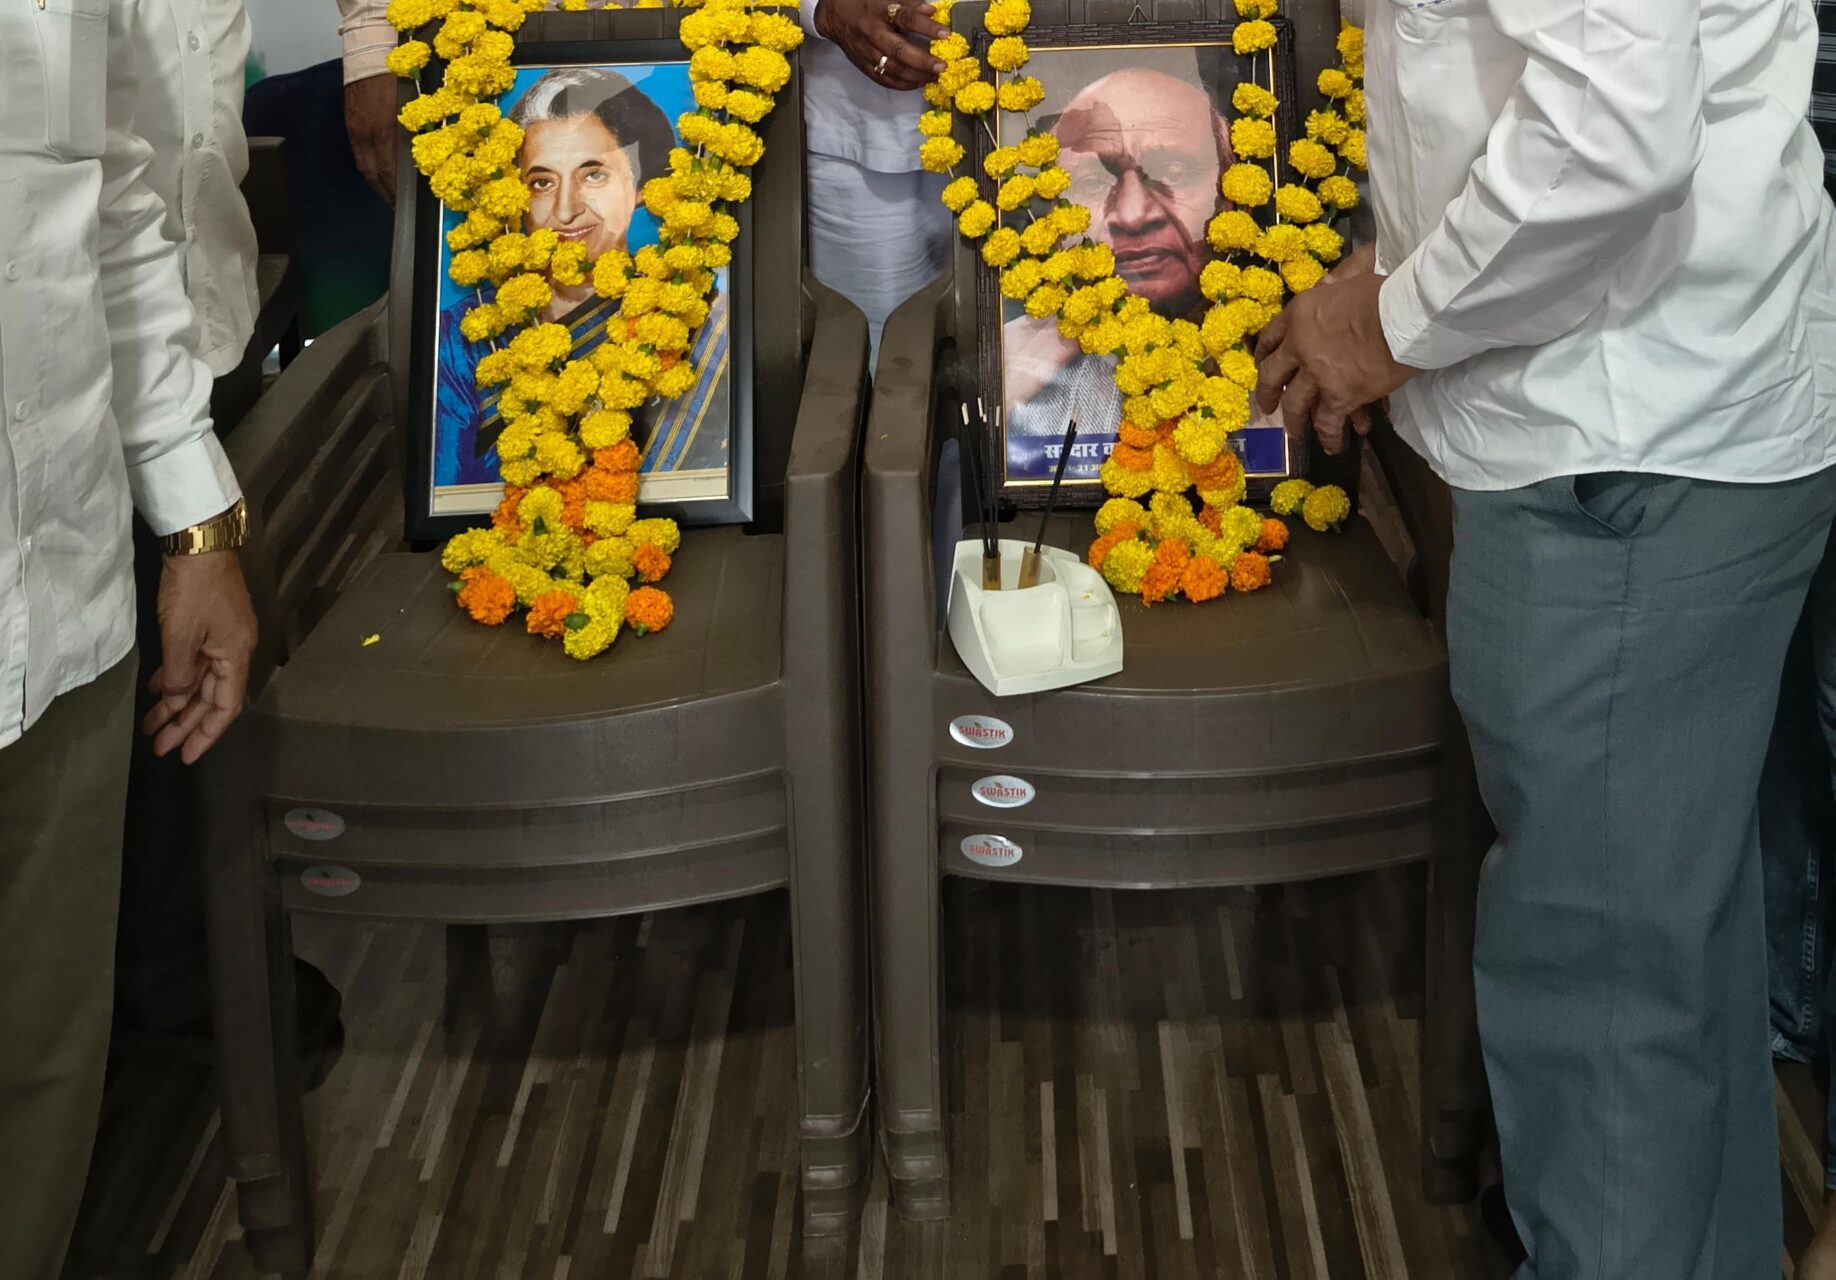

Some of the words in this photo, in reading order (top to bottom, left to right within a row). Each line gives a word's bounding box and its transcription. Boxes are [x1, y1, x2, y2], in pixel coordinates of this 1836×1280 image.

[1044, 443, 1099, 459] सदार
[958, 725, 1006, 739] SWASTIK
[979, 786, 1026, 798] SWASTIK
[968, 844, 1015, 857] SWASTIK
